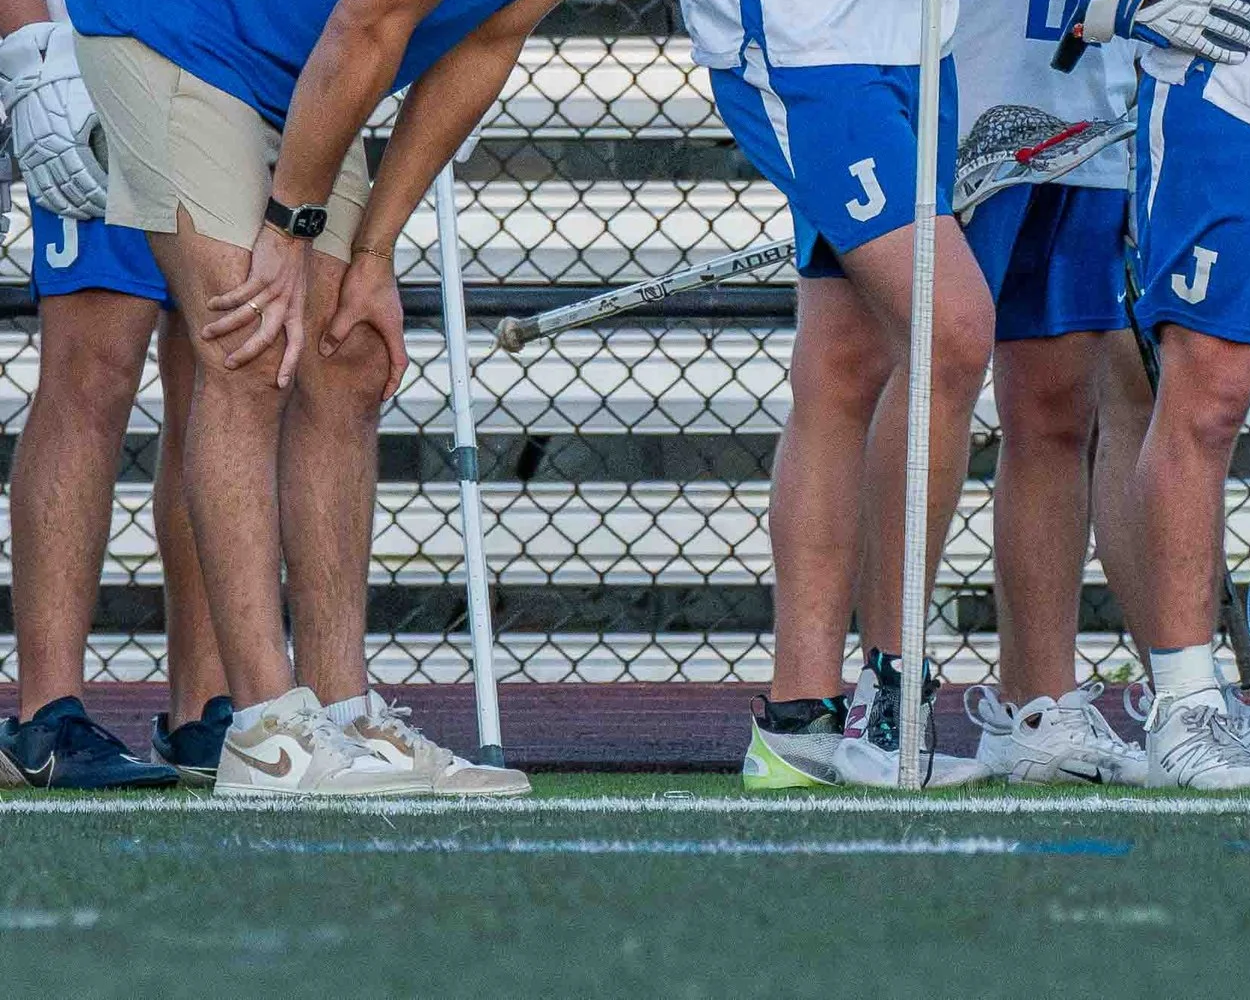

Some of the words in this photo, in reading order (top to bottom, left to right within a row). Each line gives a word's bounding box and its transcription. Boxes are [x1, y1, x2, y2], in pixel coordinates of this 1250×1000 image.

[845, 157, 887, 222] J
[45, 214, 79, 269] J
[1171, 245, 1219, 305] J
